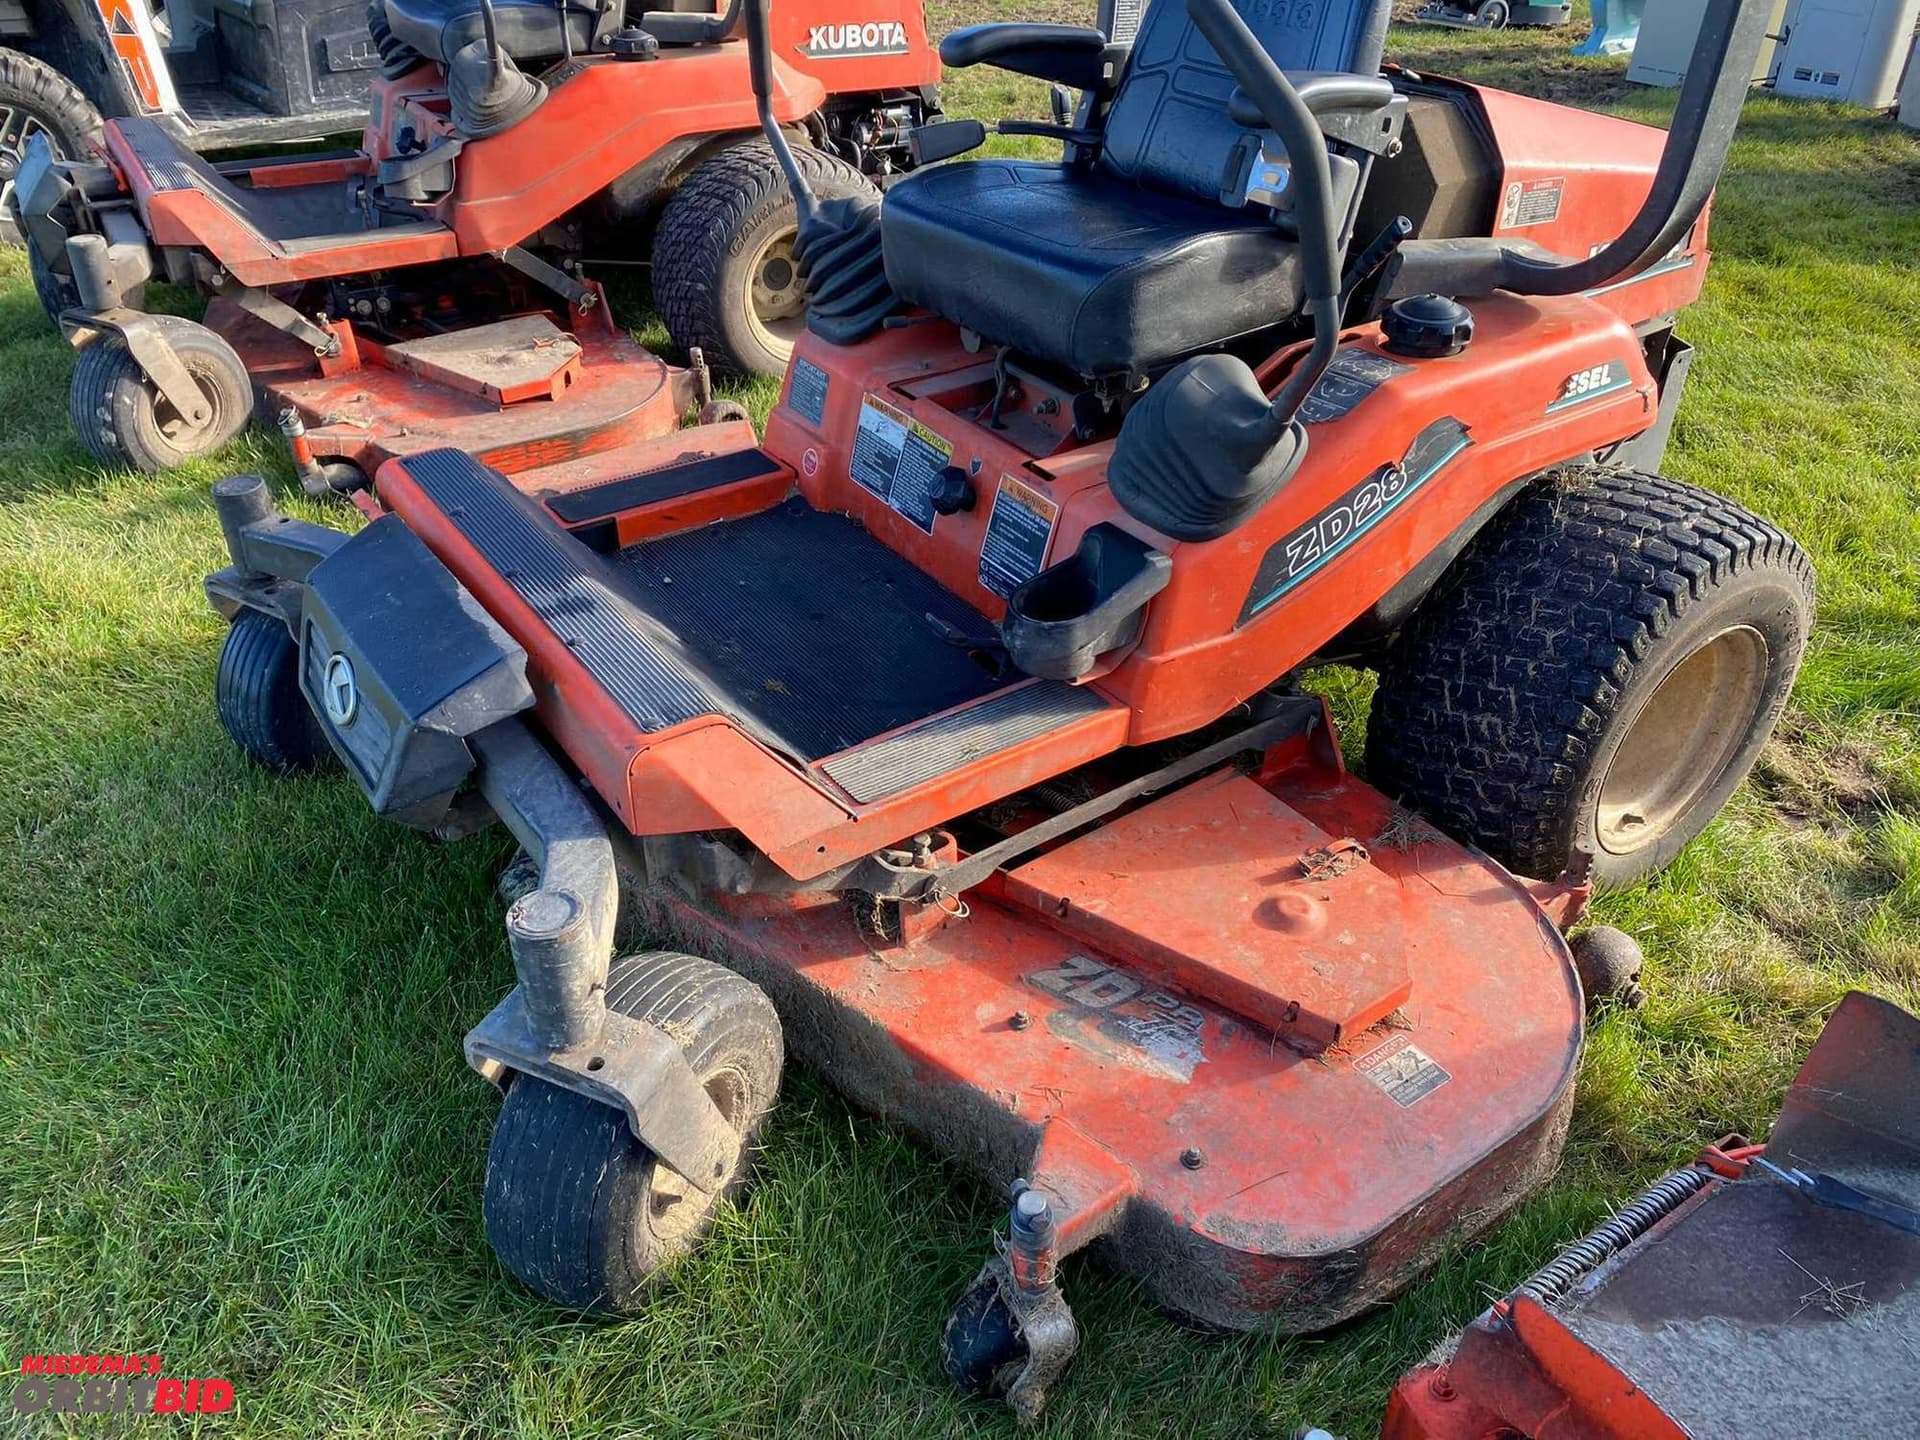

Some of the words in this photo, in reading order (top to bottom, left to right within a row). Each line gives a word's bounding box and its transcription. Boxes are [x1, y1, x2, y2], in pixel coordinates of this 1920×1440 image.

[808, 22, 907, 51] KUBOTA
[1286, 462, 1408, 577] ZD28
[1028, 953, 1144, 1009] ZD
